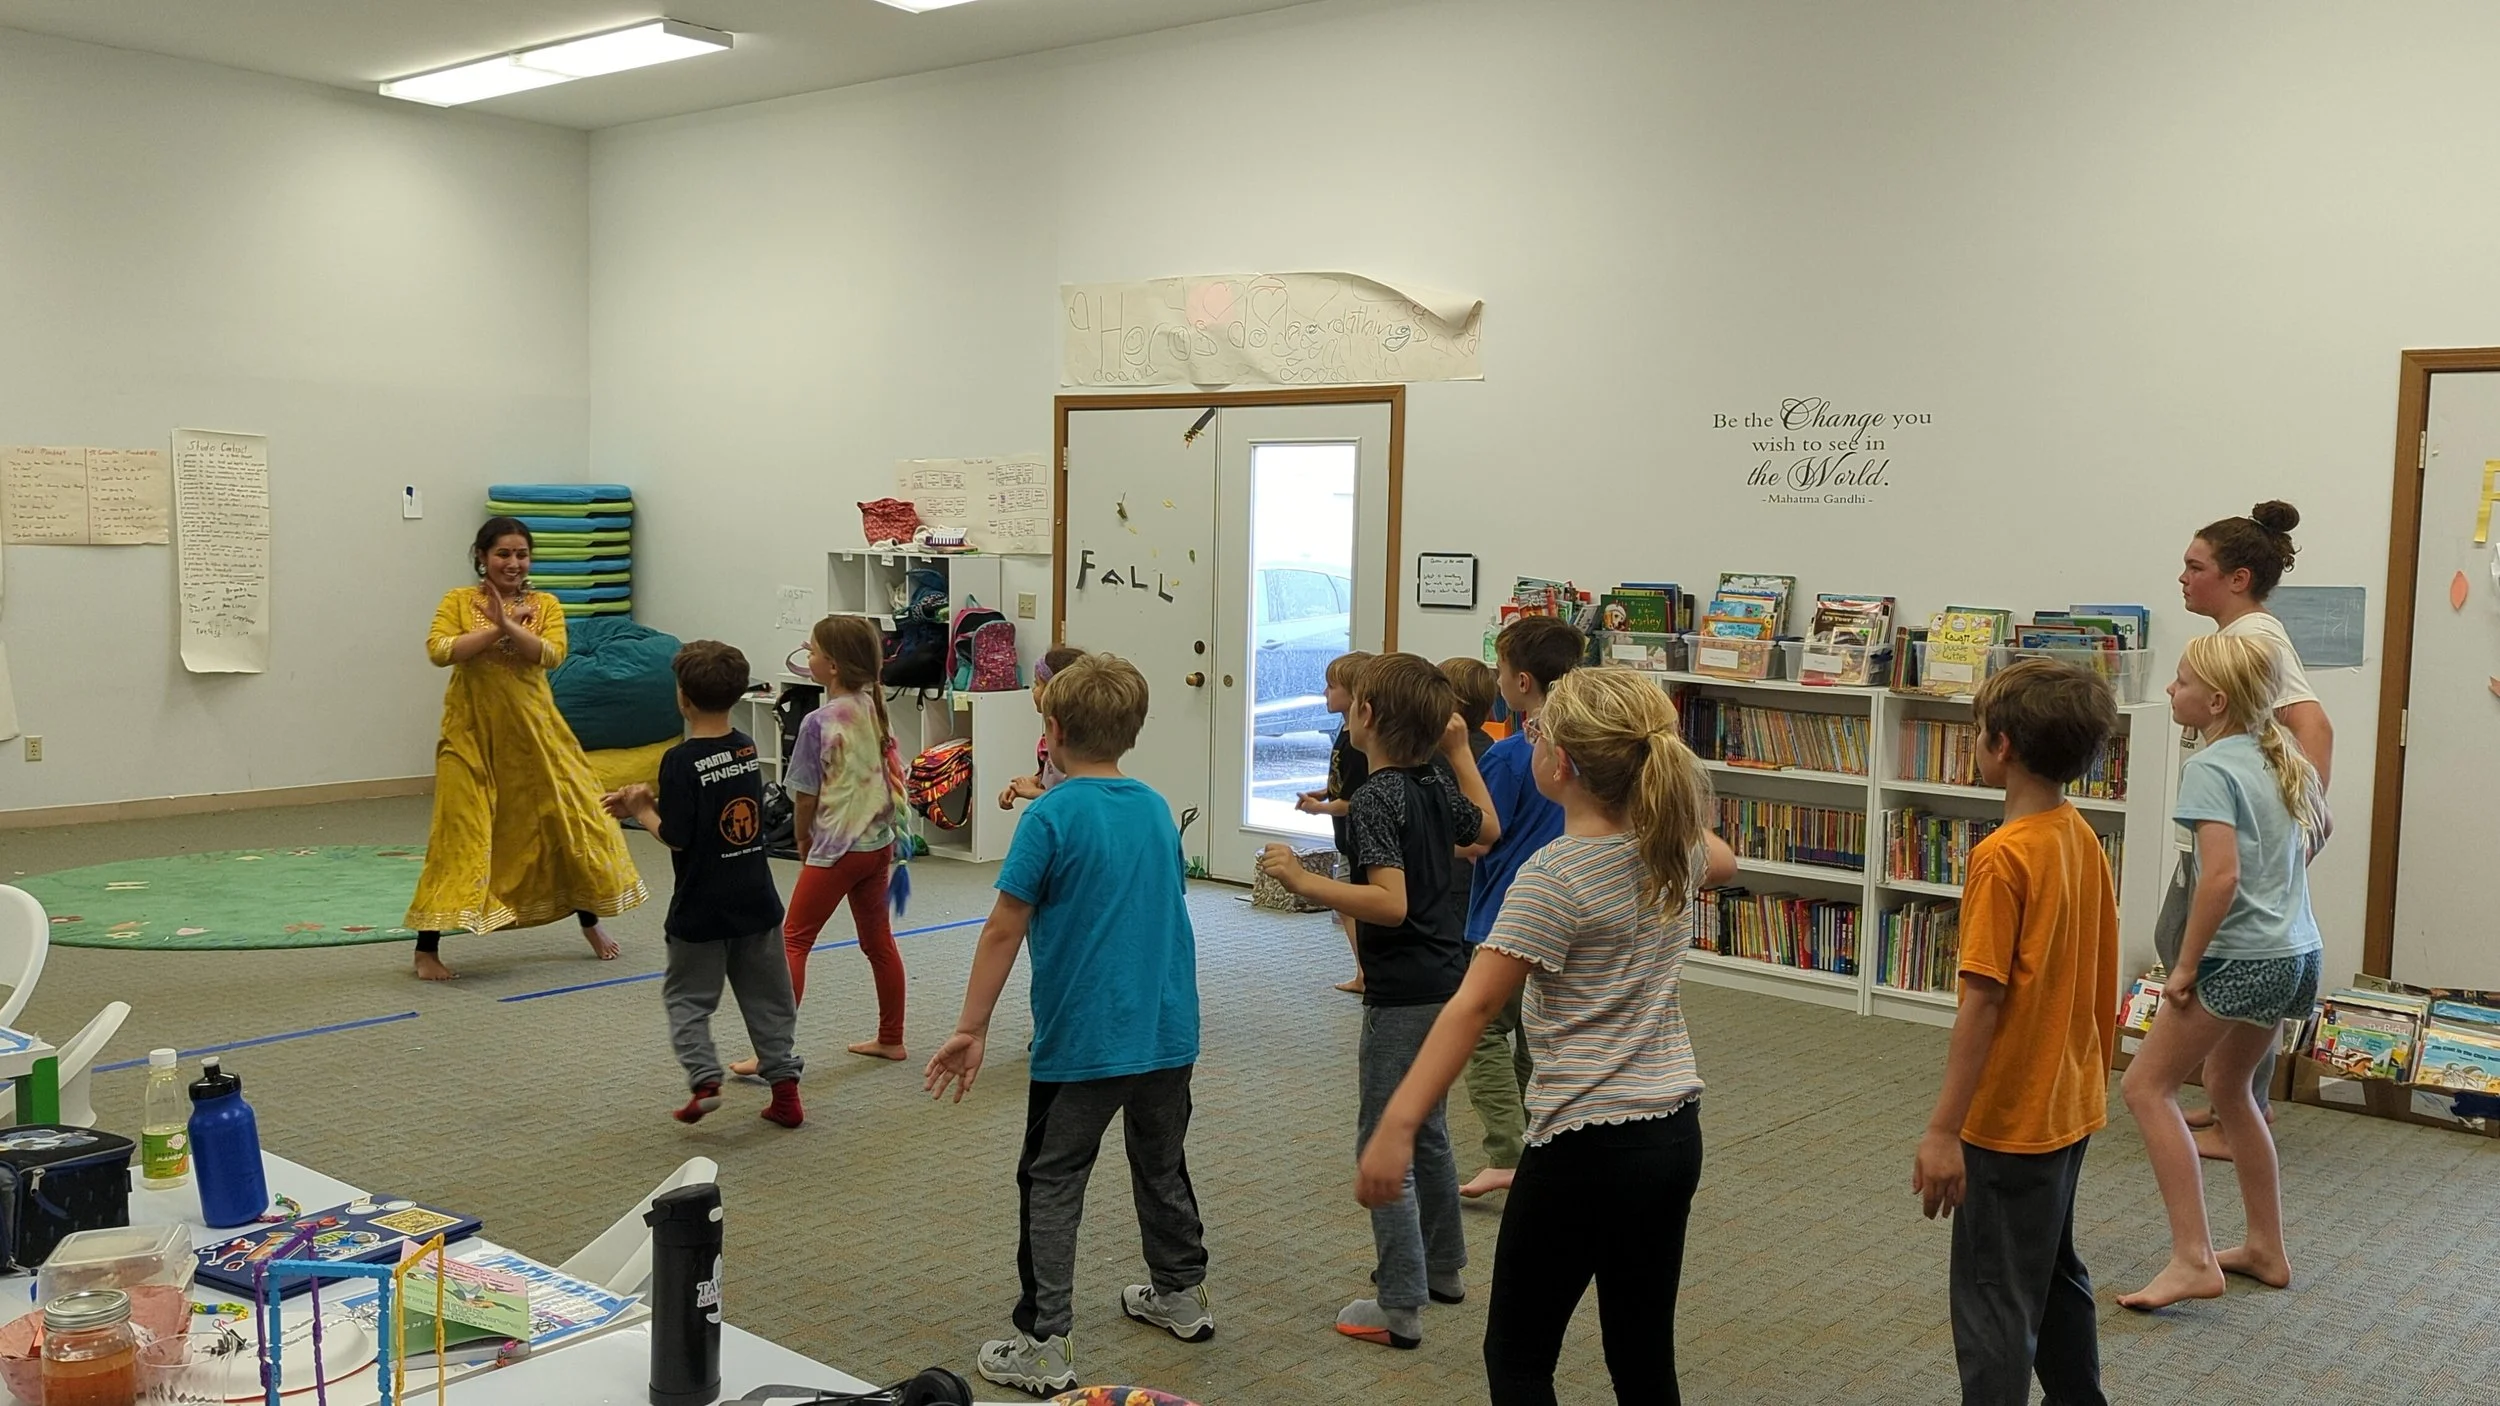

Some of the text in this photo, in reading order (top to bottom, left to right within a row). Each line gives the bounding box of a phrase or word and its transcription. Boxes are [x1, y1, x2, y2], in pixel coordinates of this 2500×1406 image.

[1227, 297, 1268, 349] do
[1713, 397, 1932, 443] Be the Change you
[1751, 436, 1886, 452] wish to see in
[1747, 451, 1890, 492] the World.
[1823, 494, 1866, 504] Gandhi
[1076, 549, 1174, 604] FALL
[694, 750, 733, 772] SPARTAN
[700, 758, 759, 787] FINISHE
